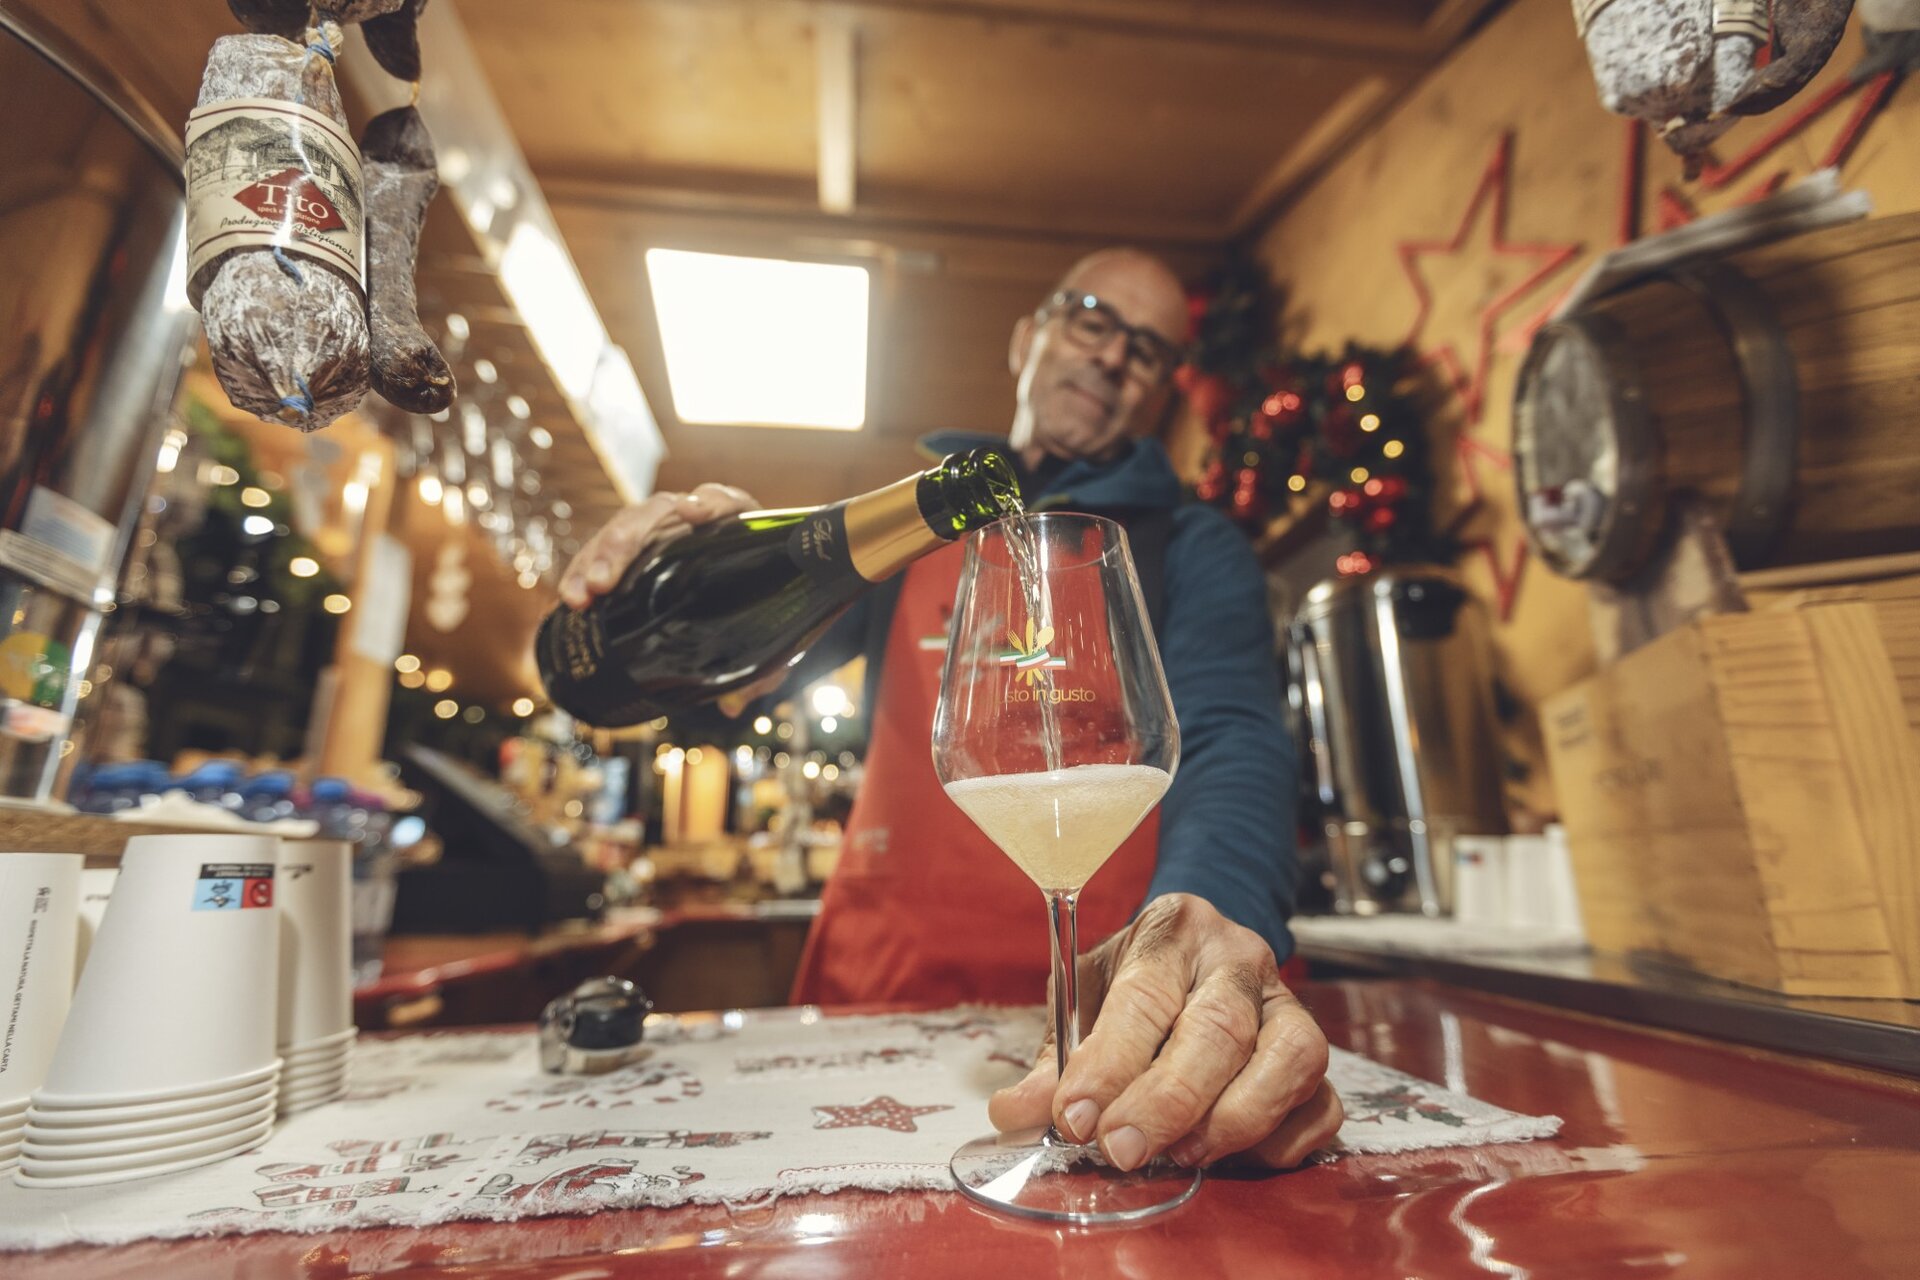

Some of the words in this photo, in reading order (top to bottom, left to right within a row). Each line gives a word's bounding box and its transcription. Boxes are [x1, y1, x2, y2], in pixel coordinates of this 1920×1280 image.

[257, 182, 328, 219] Tito
[1032, 686, 1046, 702] in
[1049, 687, 1096, 705] gusto
[0, 1048, 11, 1074] CARTA
